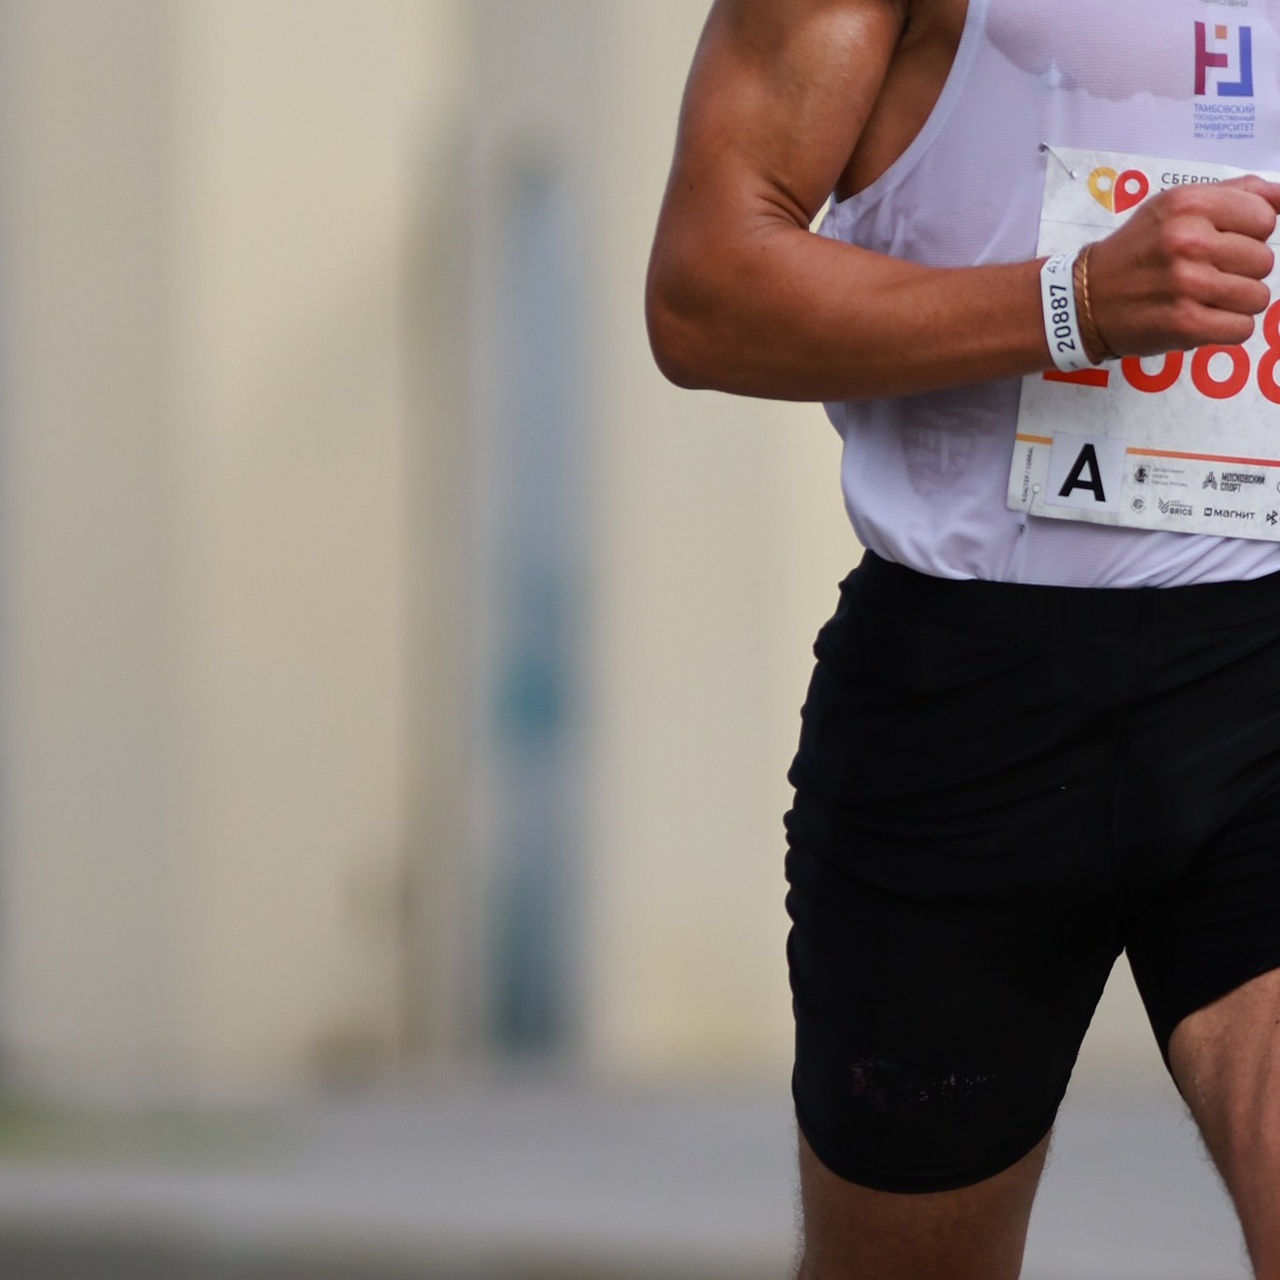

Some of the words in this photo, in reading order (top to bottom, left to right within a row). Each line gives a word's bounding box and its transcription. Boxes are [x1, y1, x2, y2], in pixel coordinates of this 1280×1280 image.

[1194, 103, 1255, 114] ТАМБОВСКИЙ
[1194, 122, 1255, 131] УНИВЕРСИТЕТ
[1049, 284, 1076, 353] 20887
[1221, 471, 1266, 485] МОСКОВСКИЙ
[1220, 482, 1242, 493] СПОРТ
[1169, 507, 1193, 517] BRICS
